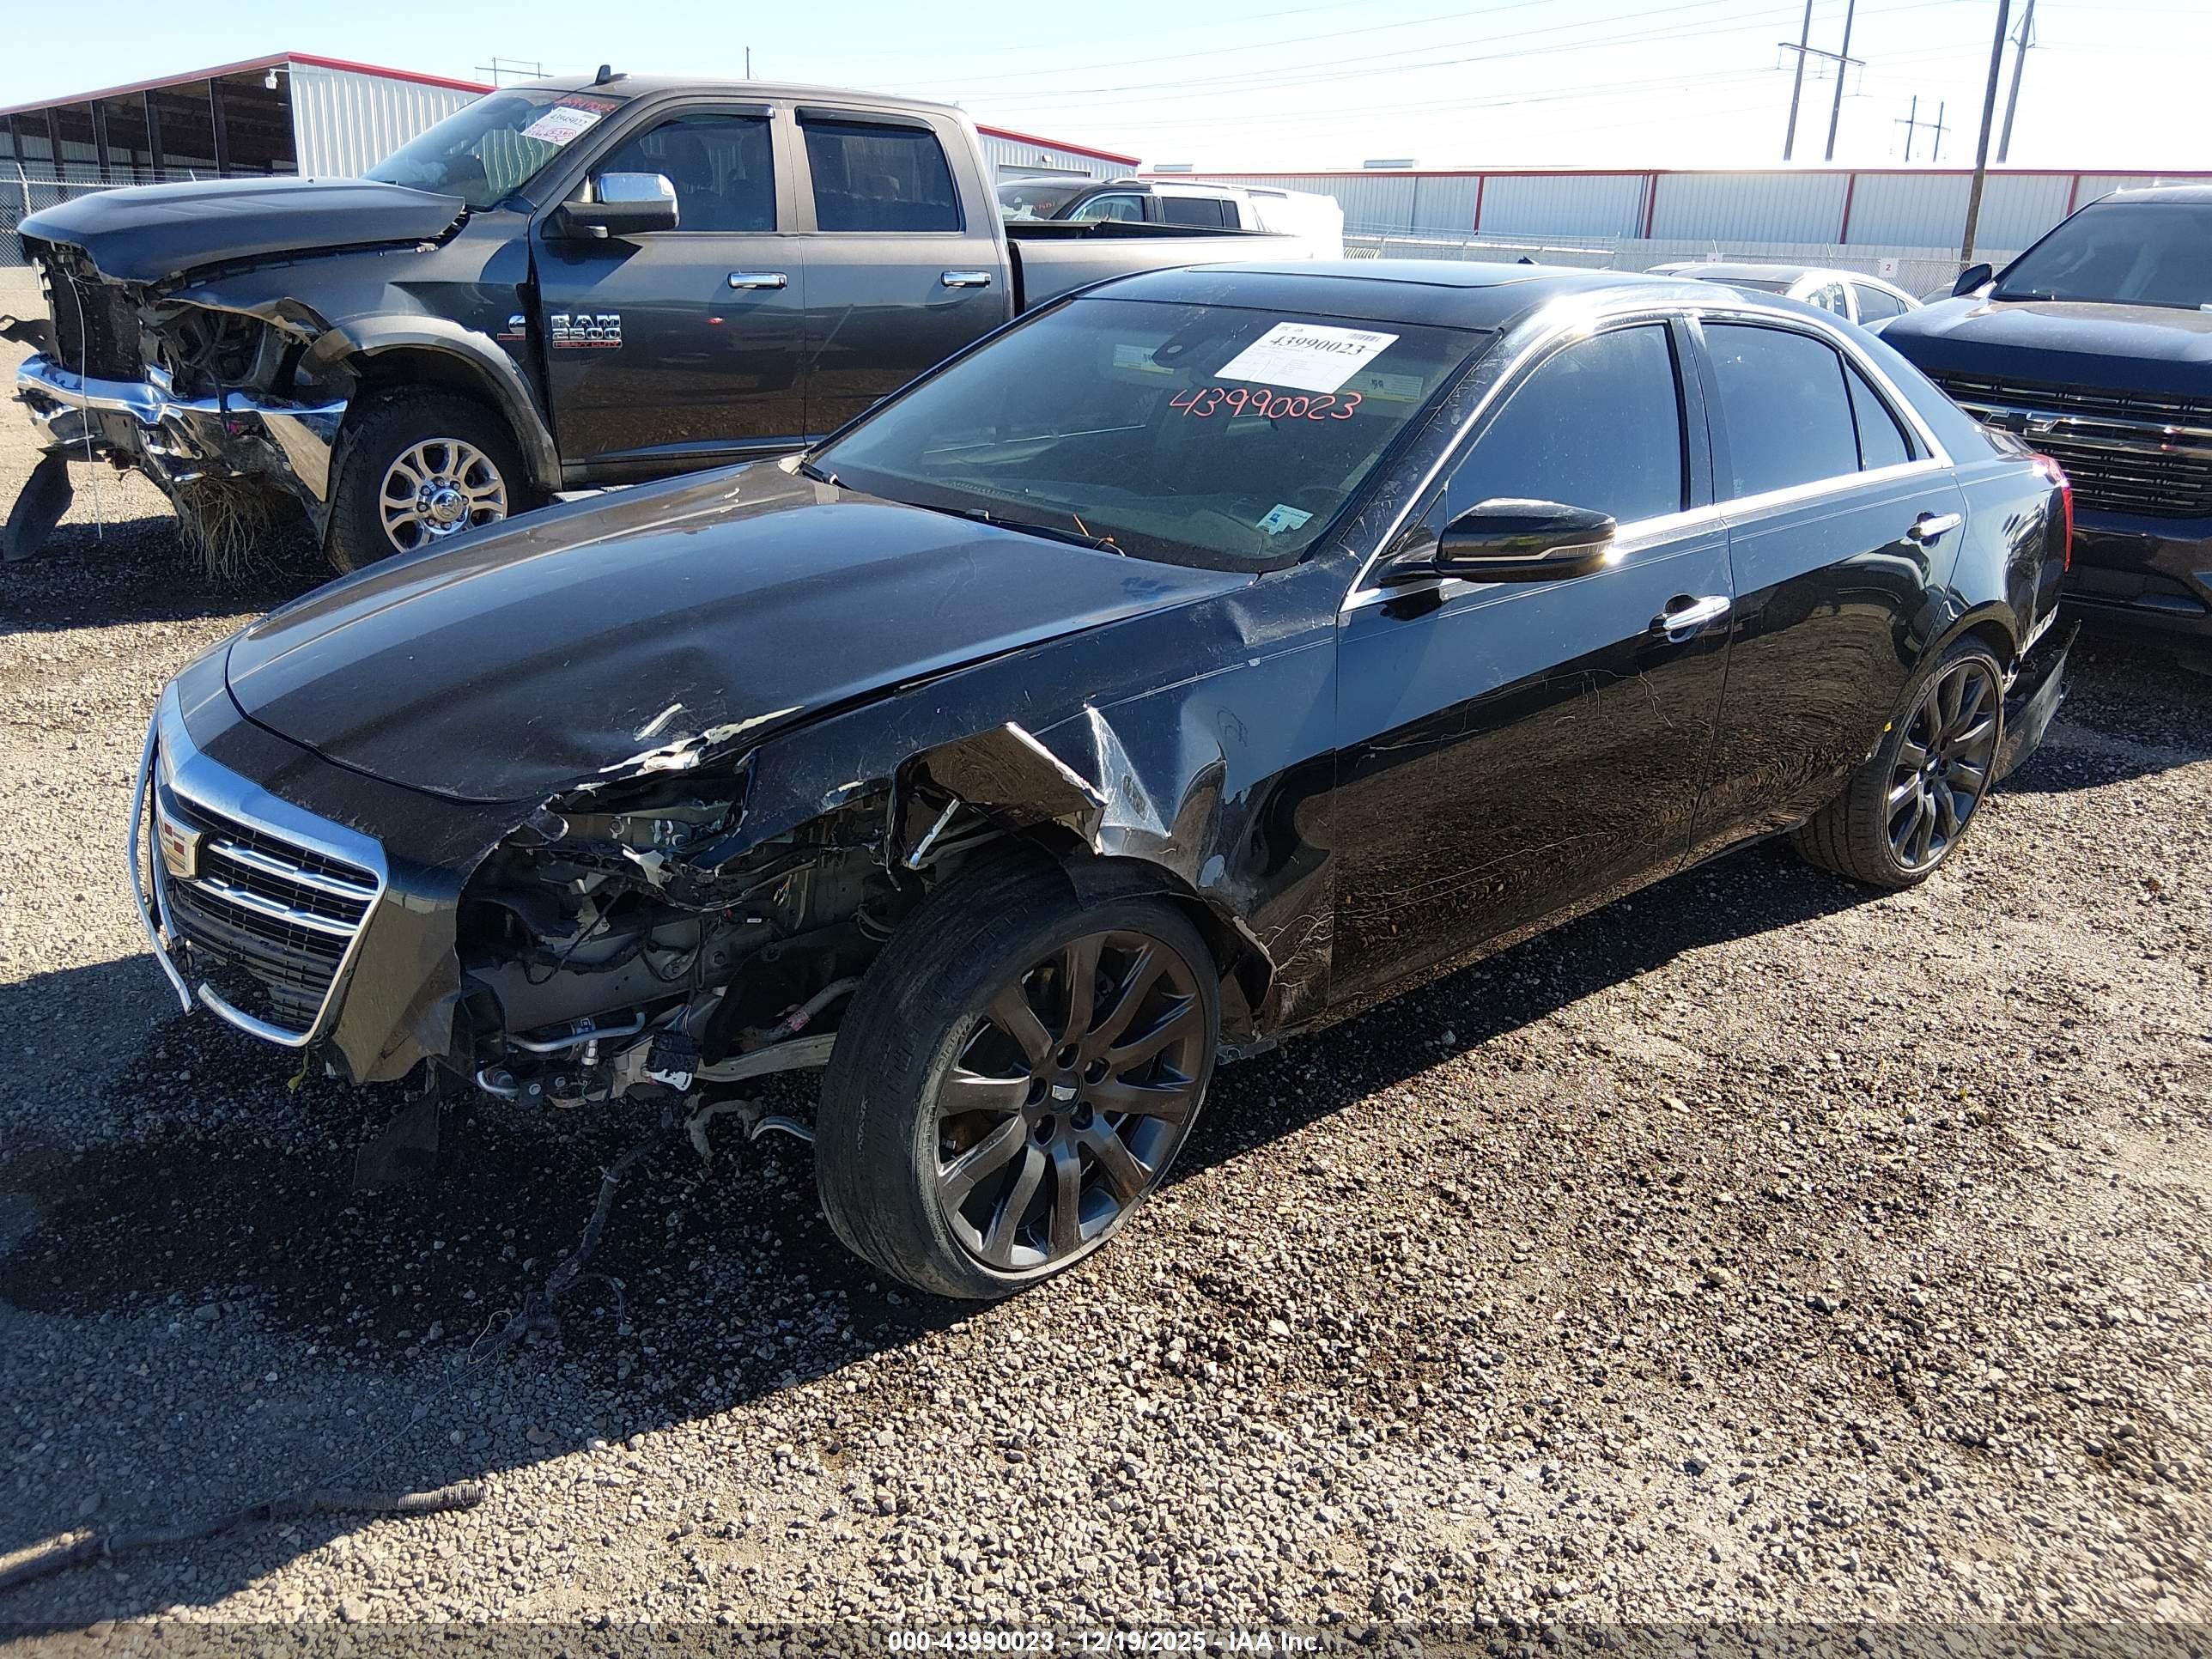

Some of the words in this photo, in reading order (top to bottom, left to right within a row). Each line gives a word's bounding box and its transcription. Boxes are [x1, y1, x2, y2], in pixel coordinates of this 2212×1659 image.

[551, 314, 621, 327] RAM
[552, 328, 622, 340] 2500
[1270, 335, 1365, 356] 43990023
[1169, 387, 1362, 420] 43990023
